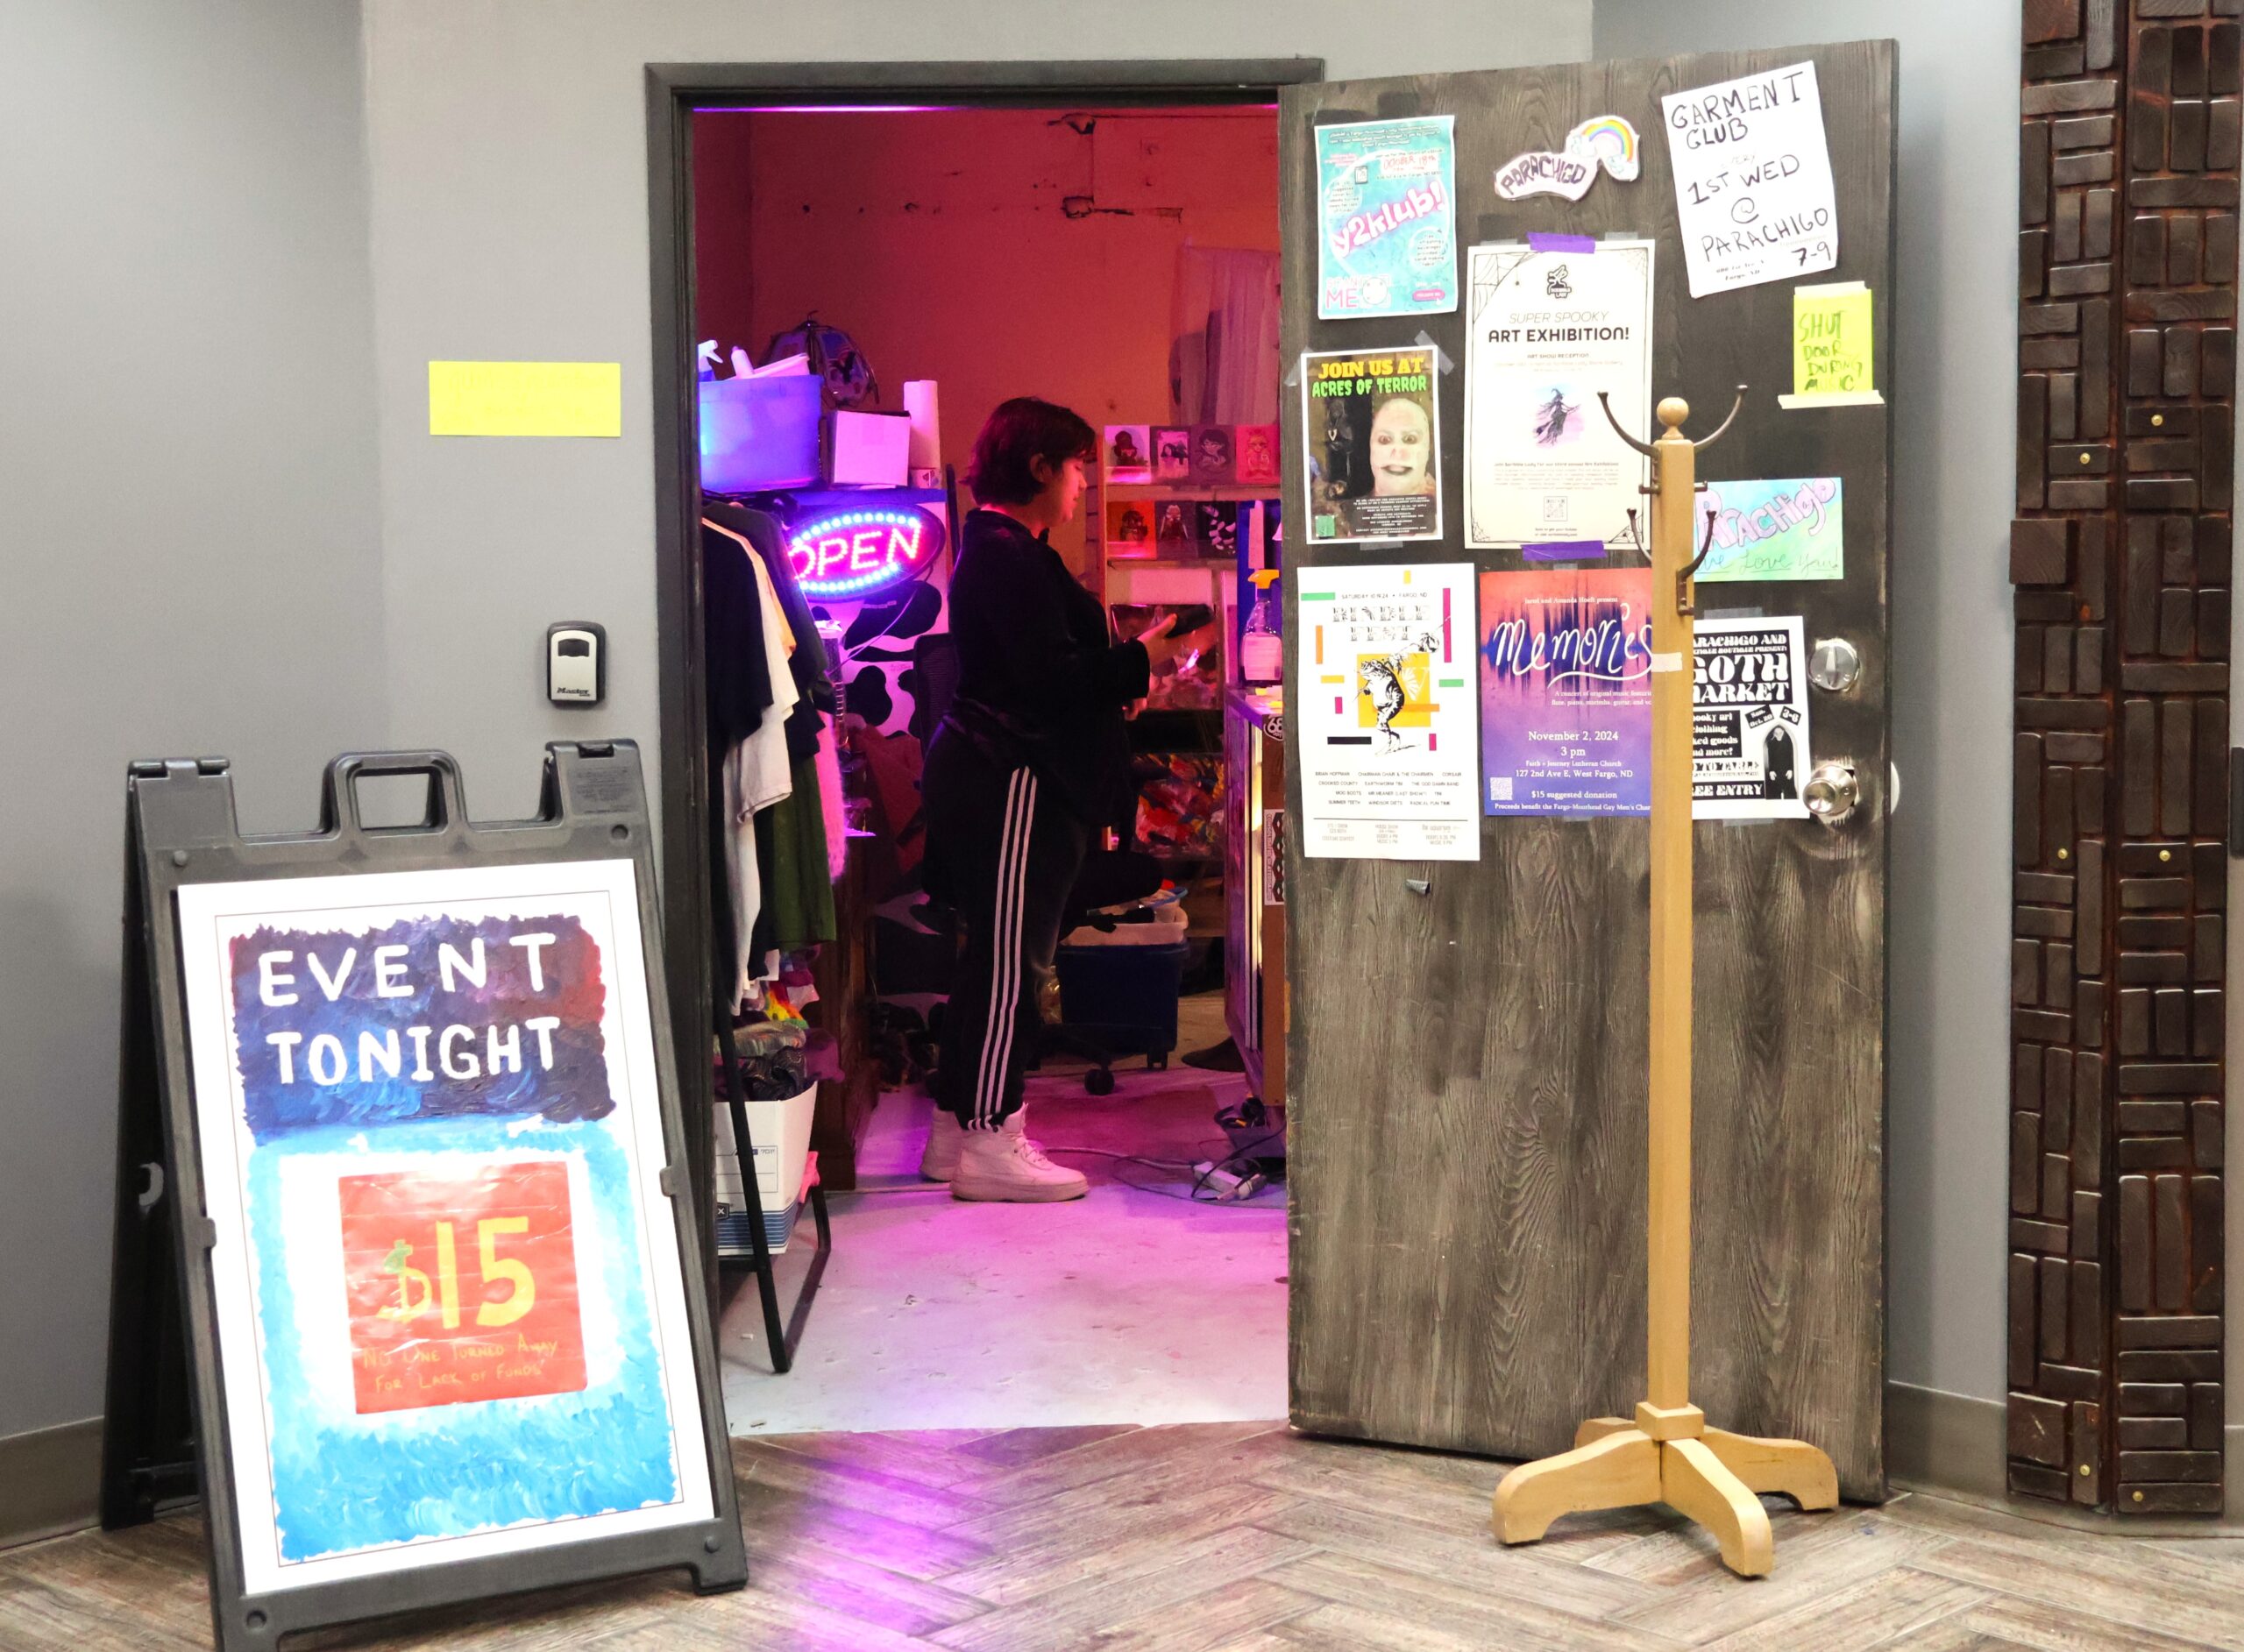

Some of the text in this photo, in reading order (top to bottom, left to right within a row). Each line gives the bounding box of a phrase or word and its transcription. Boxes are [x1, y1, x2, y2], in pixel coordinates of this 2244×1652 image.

[1671, 71, 1803, 129] GARMENT
[1501, 155, 1587, 195] PARACHIGO
[1687, 172, 1729, 205] 1ST
[1740, 154, 1800, 188] WED
[1330, 181, 1445, 259] y2klub!
[1730, 197, 1759, 224] @
[1701, 208, 1829, 262] PARACHIGO
[1791, 241, 1832, 267] 7-9
[1326, 288, 1359, 309] ME
[1509, 311, 1609, 324] SUPER SPOOKY
[1799, 310, 1847, 342] SHUT
[1488, 327, 1630, 343] ART EXHIBITION!
[1802, 340, 1848, 360] DOOR
[1318, 357, 1424, 379] JOIN US AT
[1312, 375, 1427, 398] ACRES OF TERROR
[788, 528, 922, 578] OPEN
[1494, 603, 1651, 683] Memories
[1761, 634, 1787, 645] AND
[1694, 653, 1789, 684] GOTH
[557, 686, 590, 696] Master
[1528, 731, 1619, 742] November 2, 2024
[1710, 735, 1738, 746] goods
[1547, 760, 1570, 769] Journey
[1560, 747, 1586, 758] 3 pm
[1531, 791, 1545, 799] $15
[1546, 791, 1582, 800] suggested
[1716, 783, 1763, 796] ENTRY
[259, 932, 556, 1007] EVENT
[266, 1016, 561, 1087] TONIGHT
[375, 1216, 536, 1330] $15
